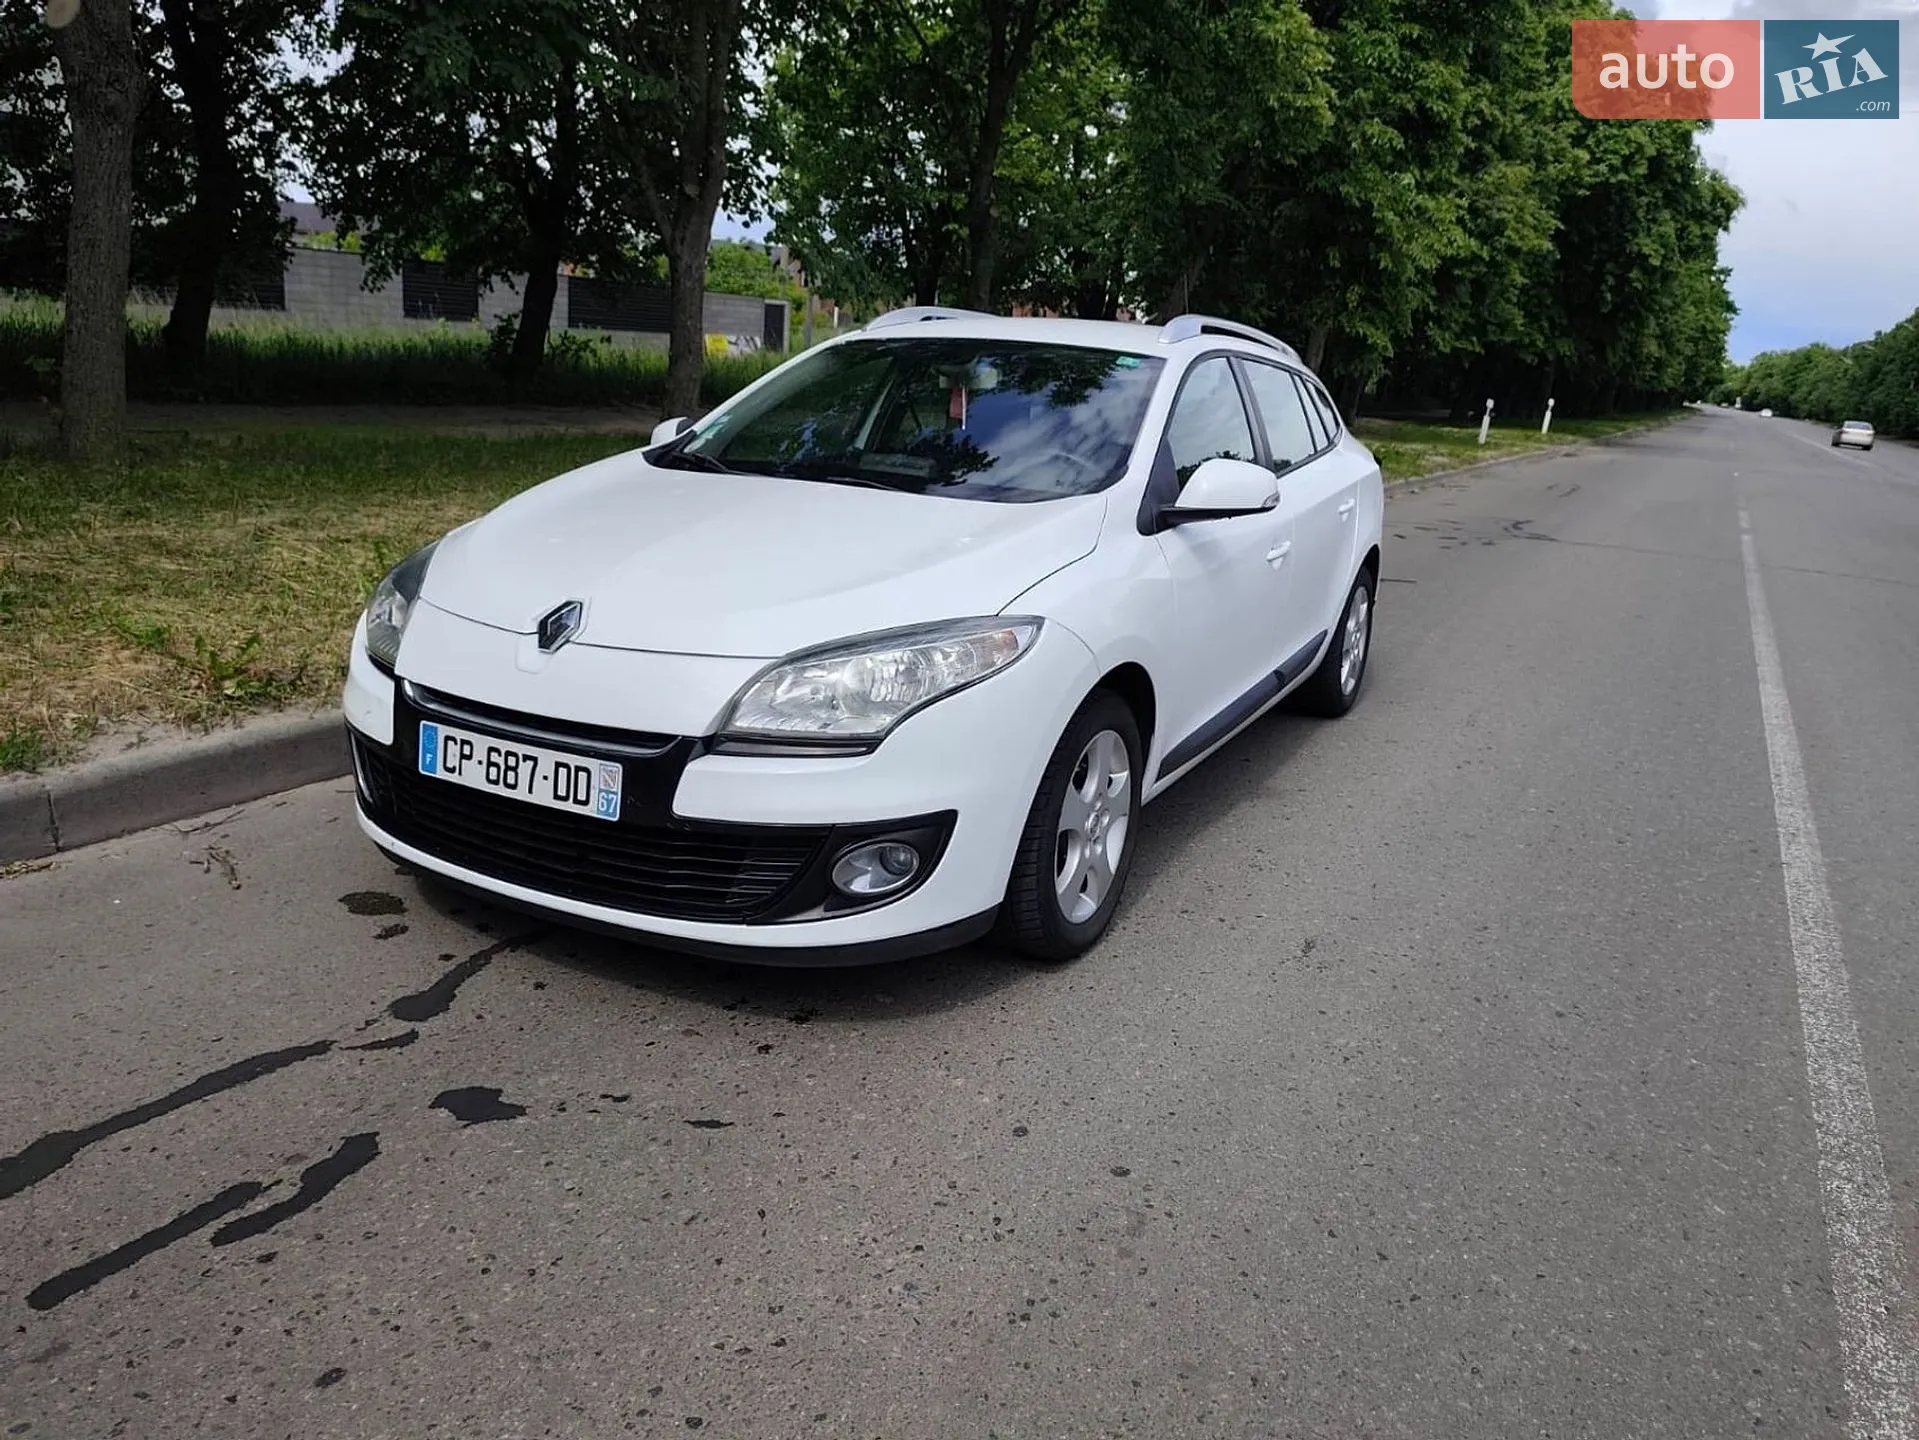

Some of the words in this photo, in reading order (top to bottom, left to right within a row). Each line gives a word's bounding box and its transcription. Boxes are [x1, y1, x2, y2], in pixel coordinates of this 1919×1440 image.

[425, 753, 432, 765] F
[442, 734, 592, 807] CP-687-DD
[598, 792, 617, 813] 67
